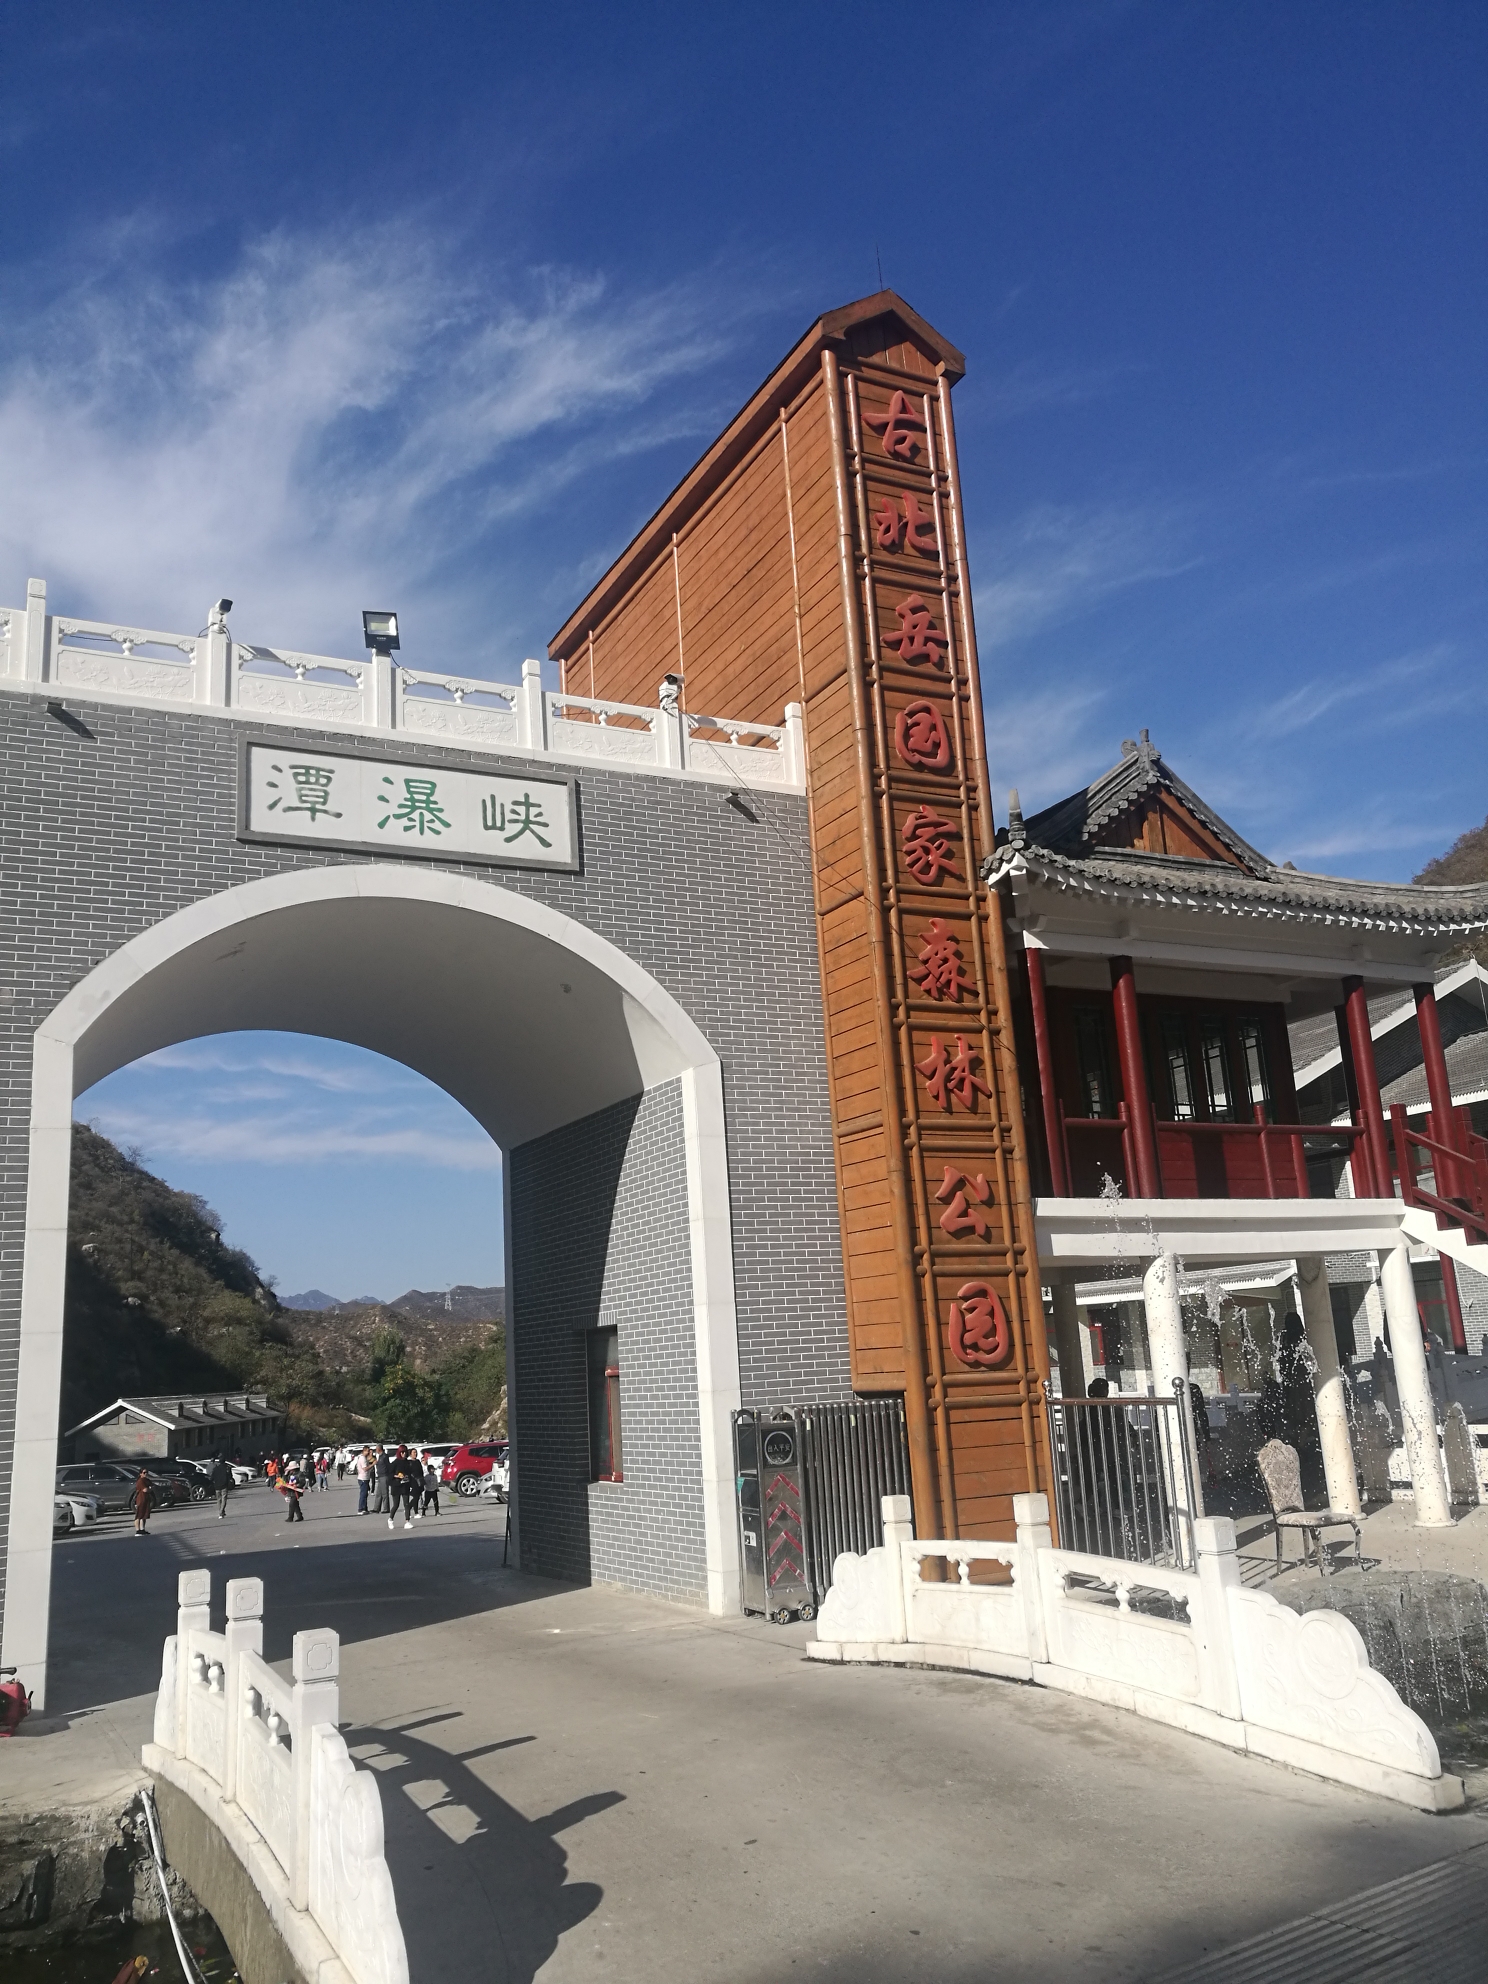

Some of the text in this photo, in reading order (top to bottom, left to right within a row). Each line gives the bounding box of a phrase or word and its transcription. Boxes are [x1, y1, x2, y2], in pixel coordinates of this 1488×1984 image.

[266, 763, 552, 849] 潭瀑峡
[862, 390, 1008, 1365] 古北岳国家森林公园
